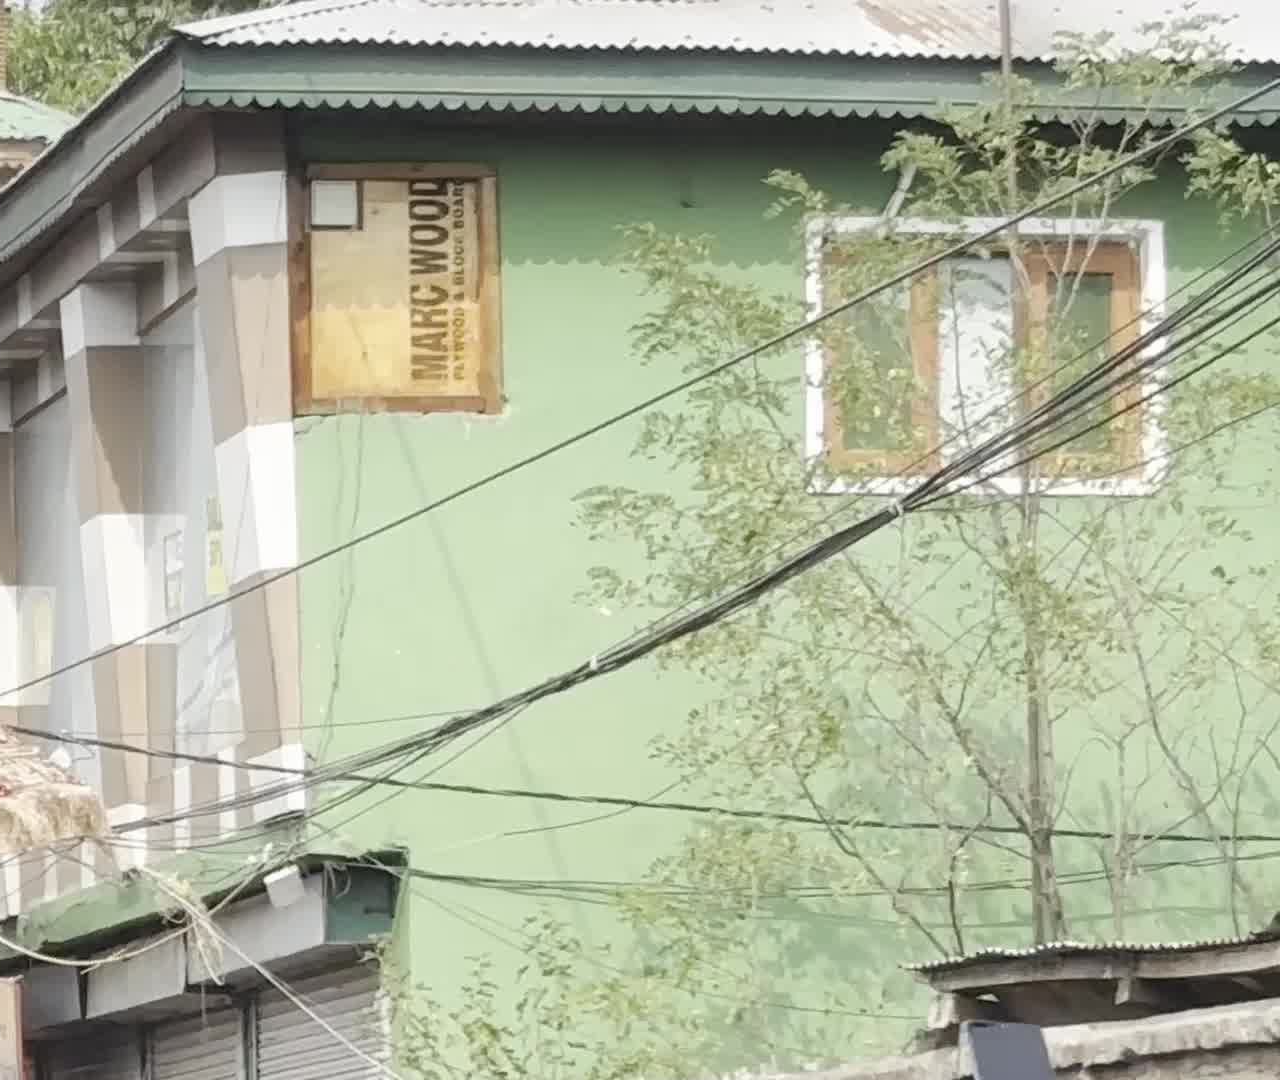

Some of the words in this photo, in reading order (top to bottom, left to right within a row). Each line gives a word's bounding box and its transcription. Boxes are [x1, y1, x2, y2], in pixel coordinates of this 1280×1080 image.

[408, 178, 450, 276] WOOD
[409, 284, 449, 381] MARC
[452, 307, 465, 381] PLYWOOD
